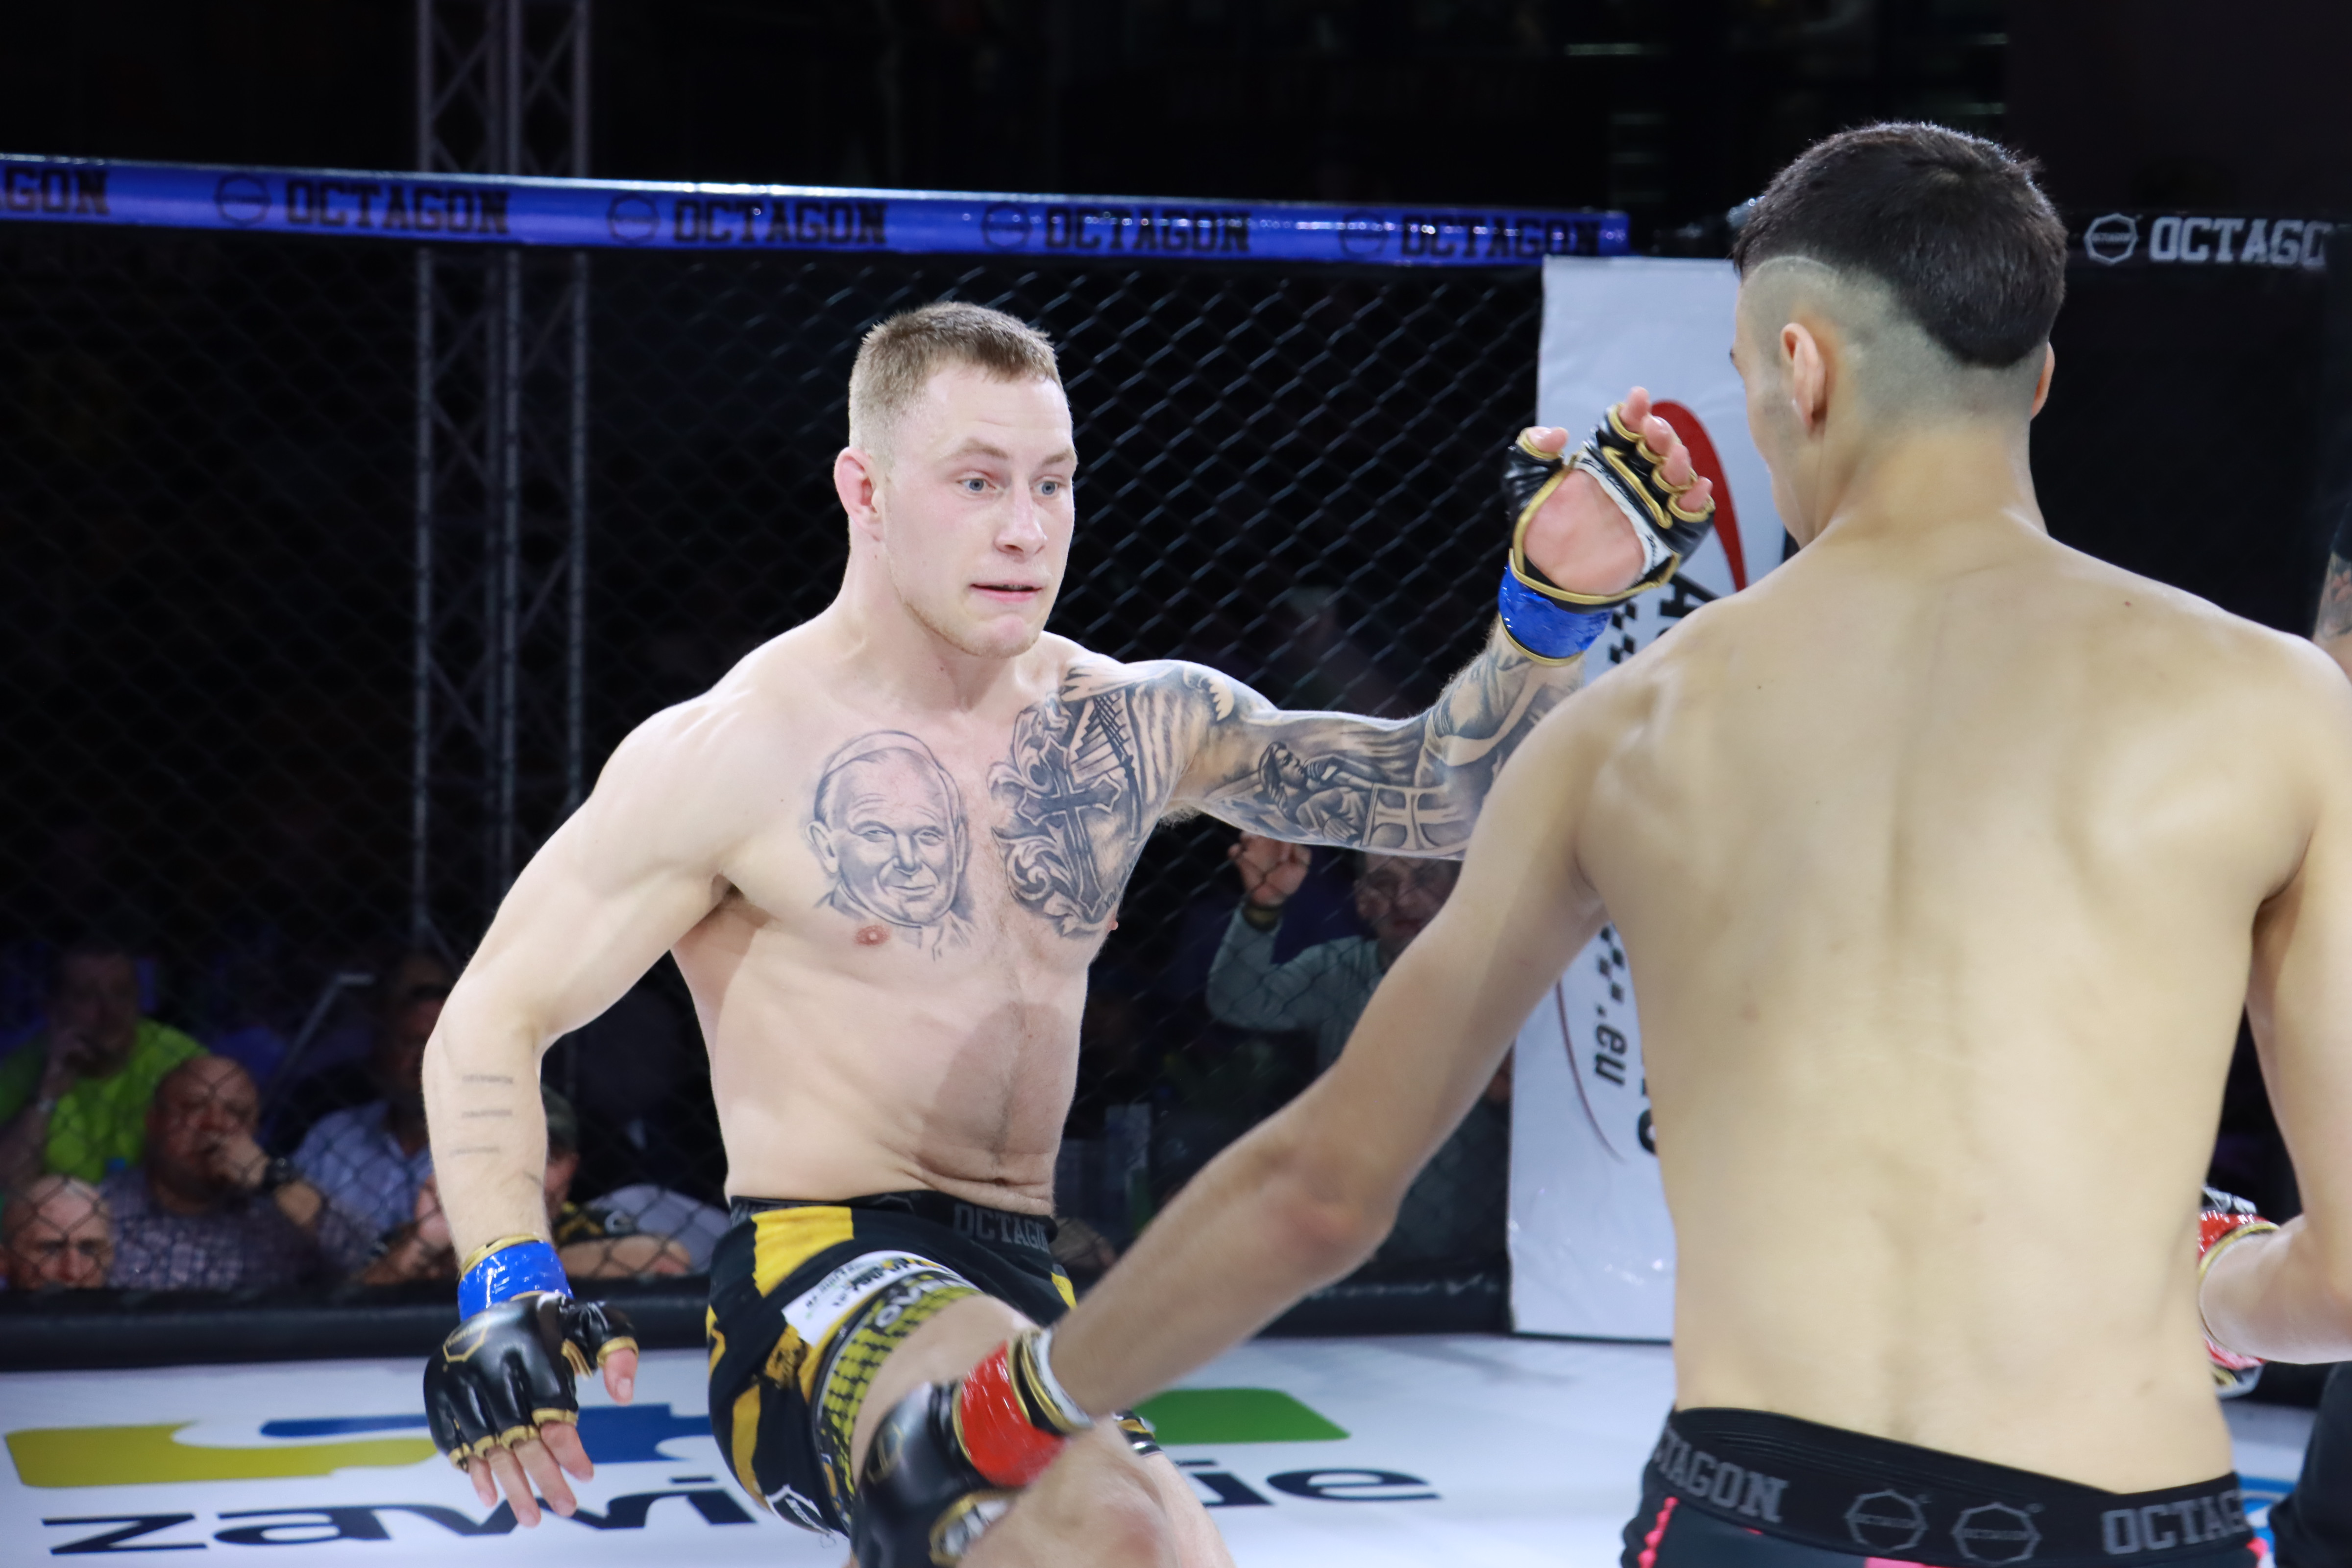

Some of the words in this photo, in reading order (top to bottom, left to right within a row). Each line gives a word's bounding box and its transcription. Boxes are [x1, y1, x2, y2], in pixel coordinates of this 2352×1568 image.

[6, 167, 110, 216] GON
[286, 181, 509, 234] OCTAGON
[673, 199, 887, 245] OCTAGON
[1045, 206, 1251, 252] OCTAGON
[1401, 215, 1600, 258] OCTAGON
[1654, 1425, 1790, 1523] TAGON
